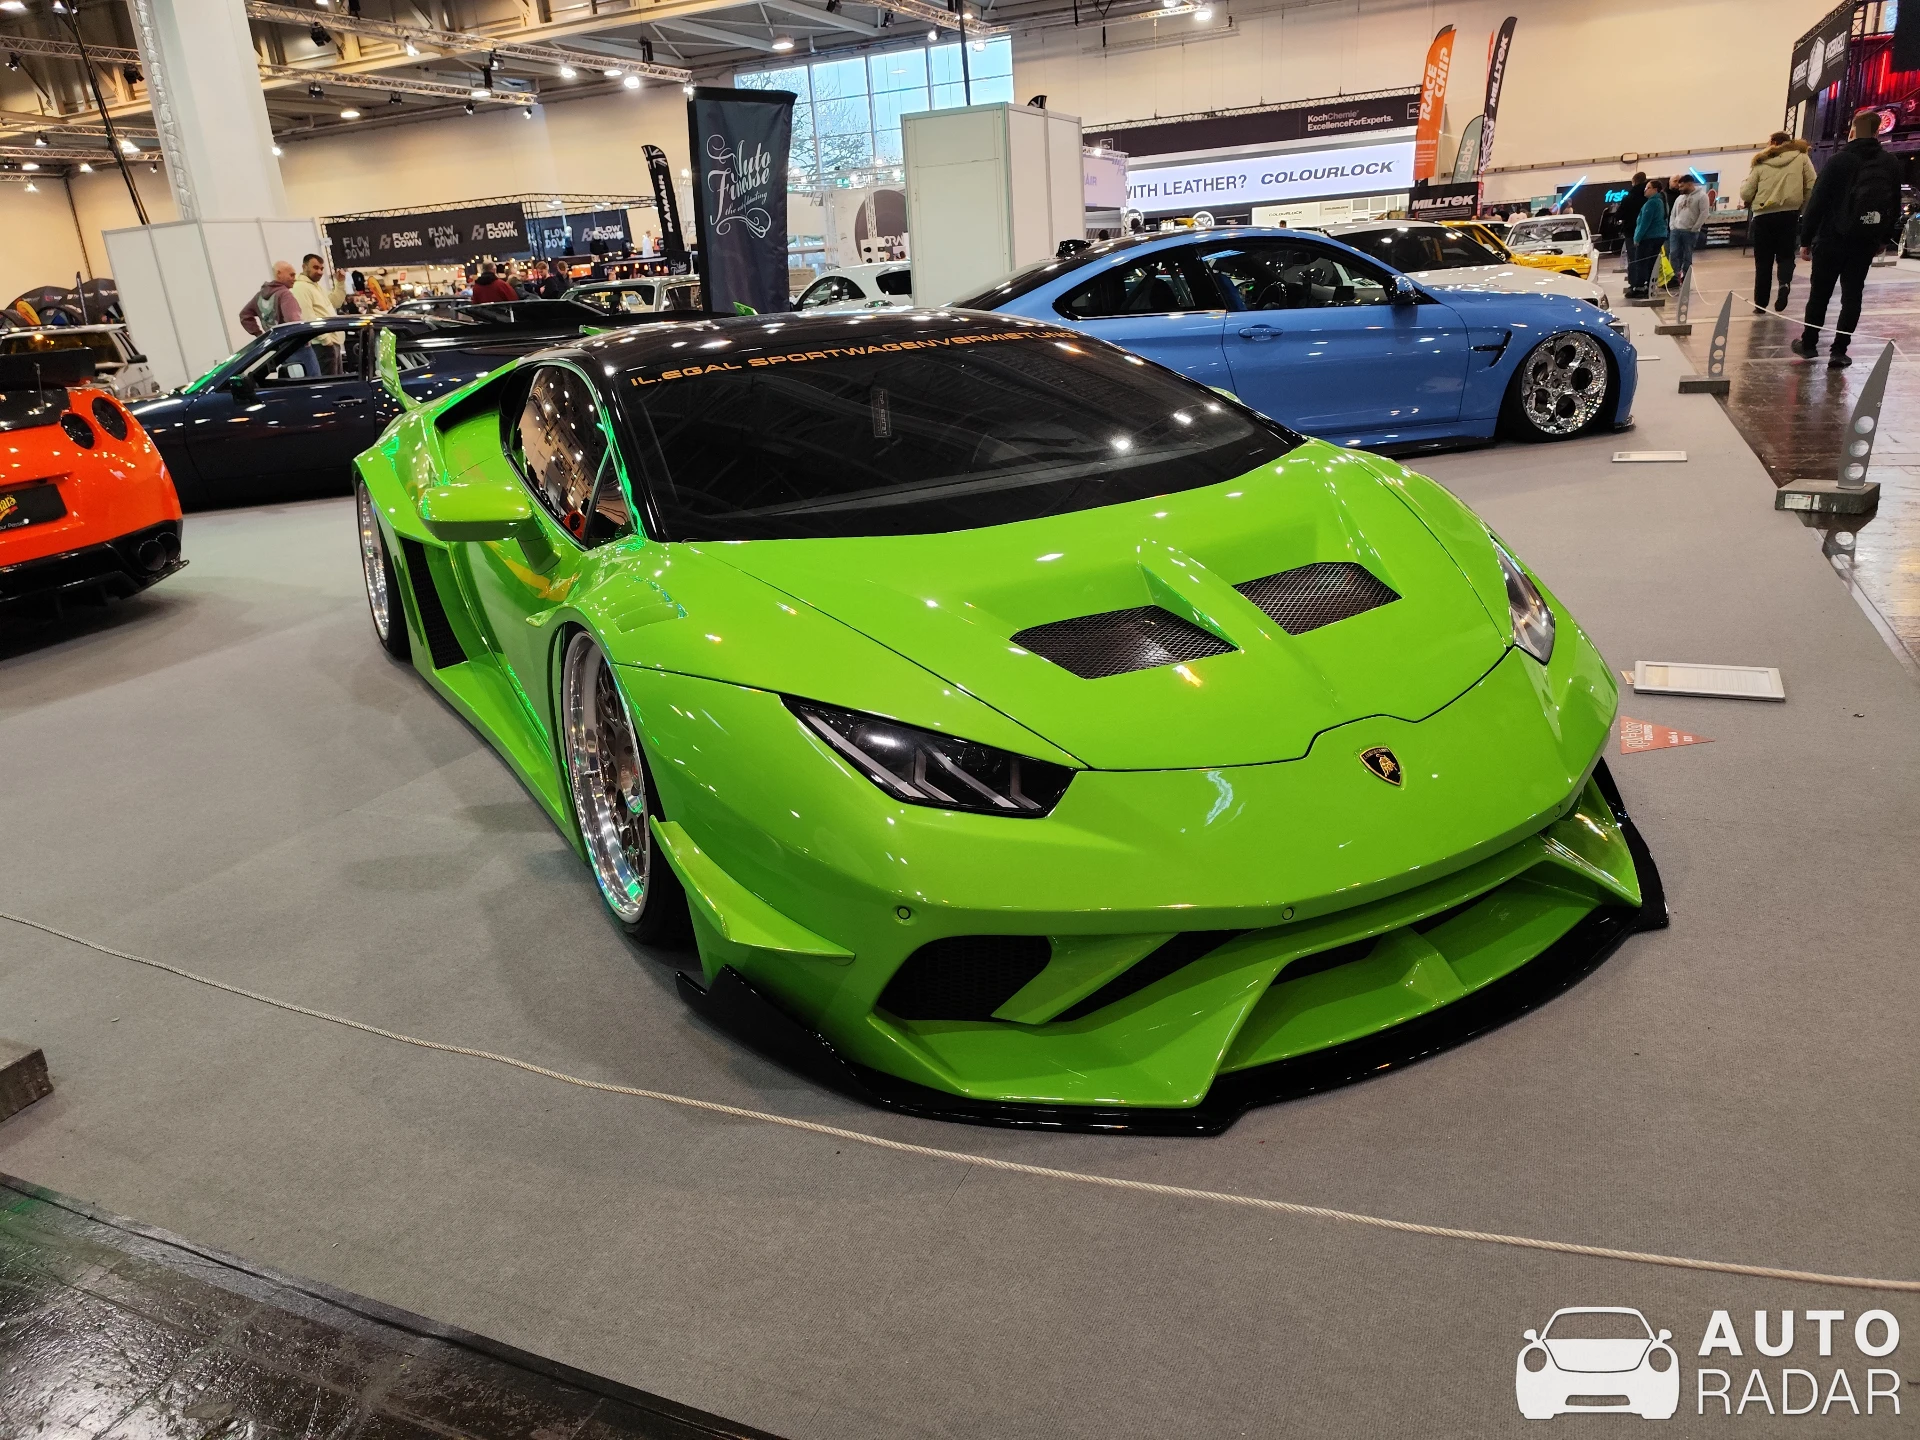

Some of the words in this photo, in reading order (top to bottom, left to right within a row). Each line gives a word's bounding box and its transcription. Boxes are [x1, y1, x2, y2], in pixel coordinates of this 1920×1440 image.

[1435, 47, 1450, 98] CHIP
[1420, 64, 1437, 121] RACE
[1308, 115, 1394, 132] ExcellenceForExperts.
[1084, 174, 1098, 187] AIR
[1260, 160, 1395, 186] COLOURLOCK
[1163, 174, 1247, 196] LEATHER?
[658, 175, 674, 232] RAMAIR
[707, 168, 770, 226] Finesse
[428, 224, 455, 239] FLOW
[485, 221, 515, 233] FLOW
[487, 228, 519, 240] DOWN
[342, 235, 371, 249] FLOW
[391, 230, 419, 241] FLOW
[393, 237, 423, 249] DOWN
[434, 233, 459, 249] DOWN
[345, 248, 371, 260] DOWN
[630, 362, 742, 387] IL.EGAL
[747, 331, 1079, 367] SPORTWAGENVERMIETUNG
